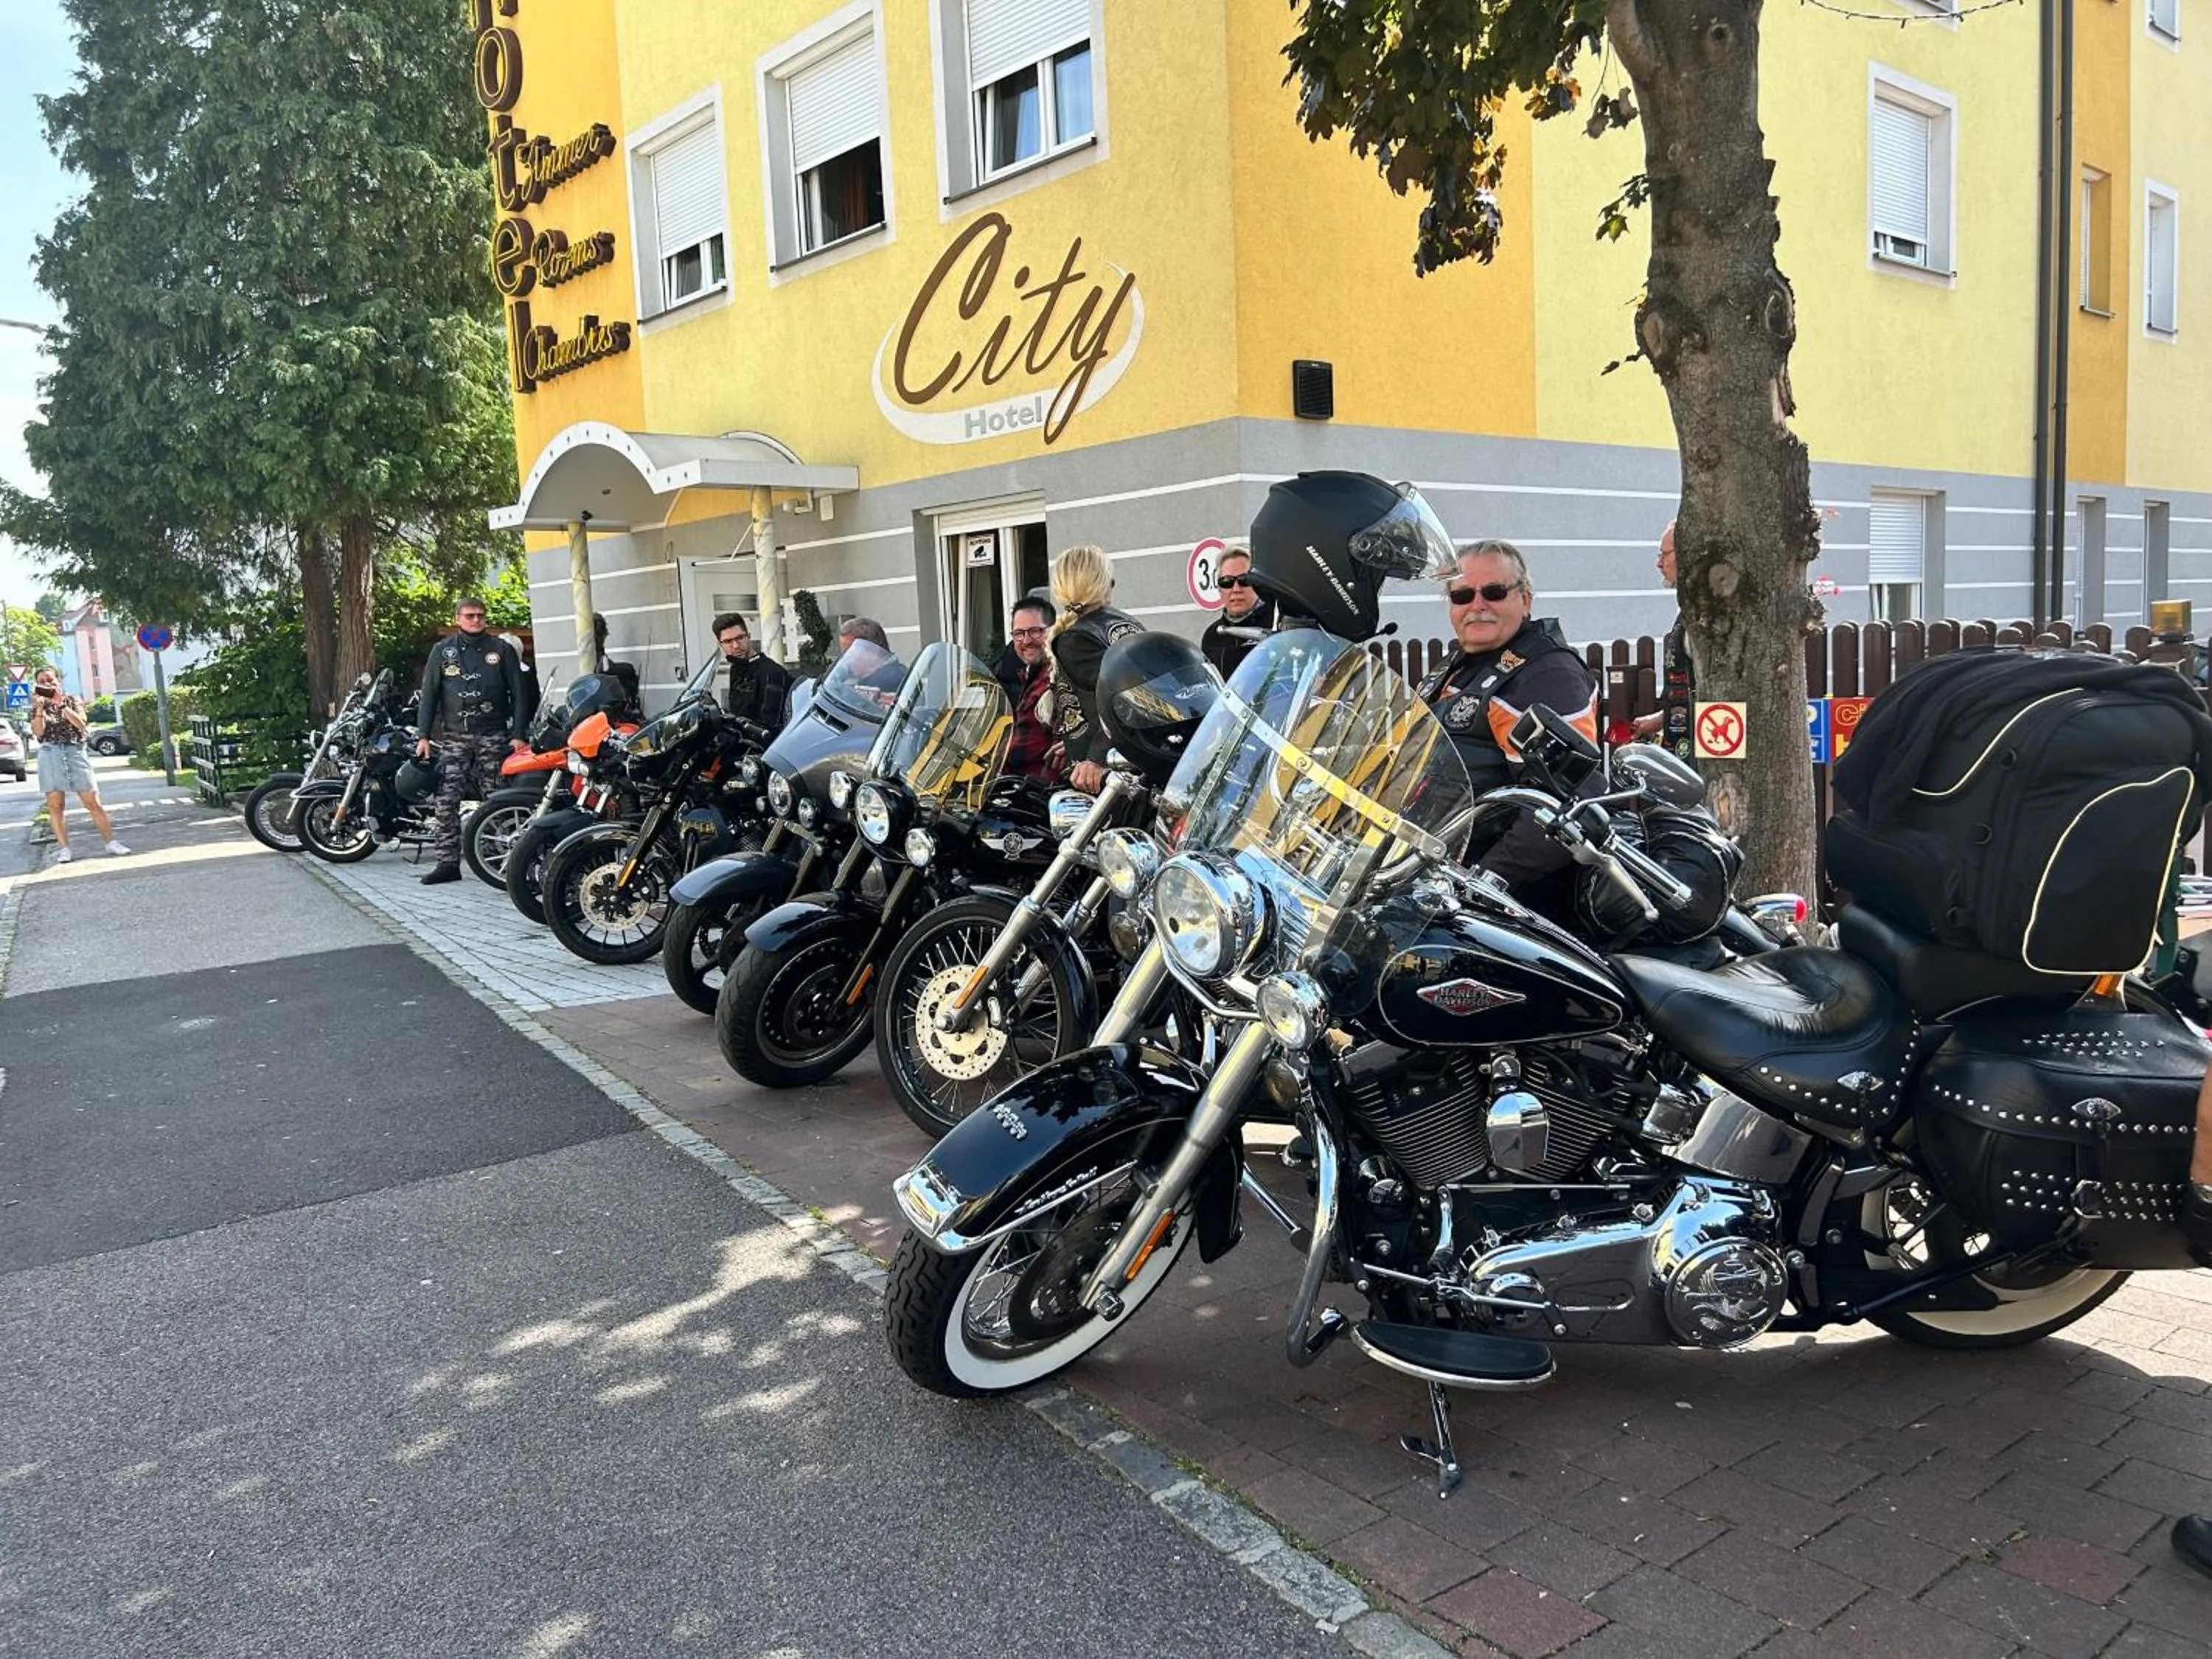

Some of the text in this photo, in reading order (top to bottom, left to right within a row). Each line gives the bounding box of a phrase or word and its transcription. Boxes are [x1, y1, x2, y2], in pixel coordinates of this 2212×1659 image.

[531, 229, 615, 288] Rooms
[524, 315, 631, 382] Chambres
[894, 212, 1135, 445] City
[964, 396, 1043, 438] Hotel
